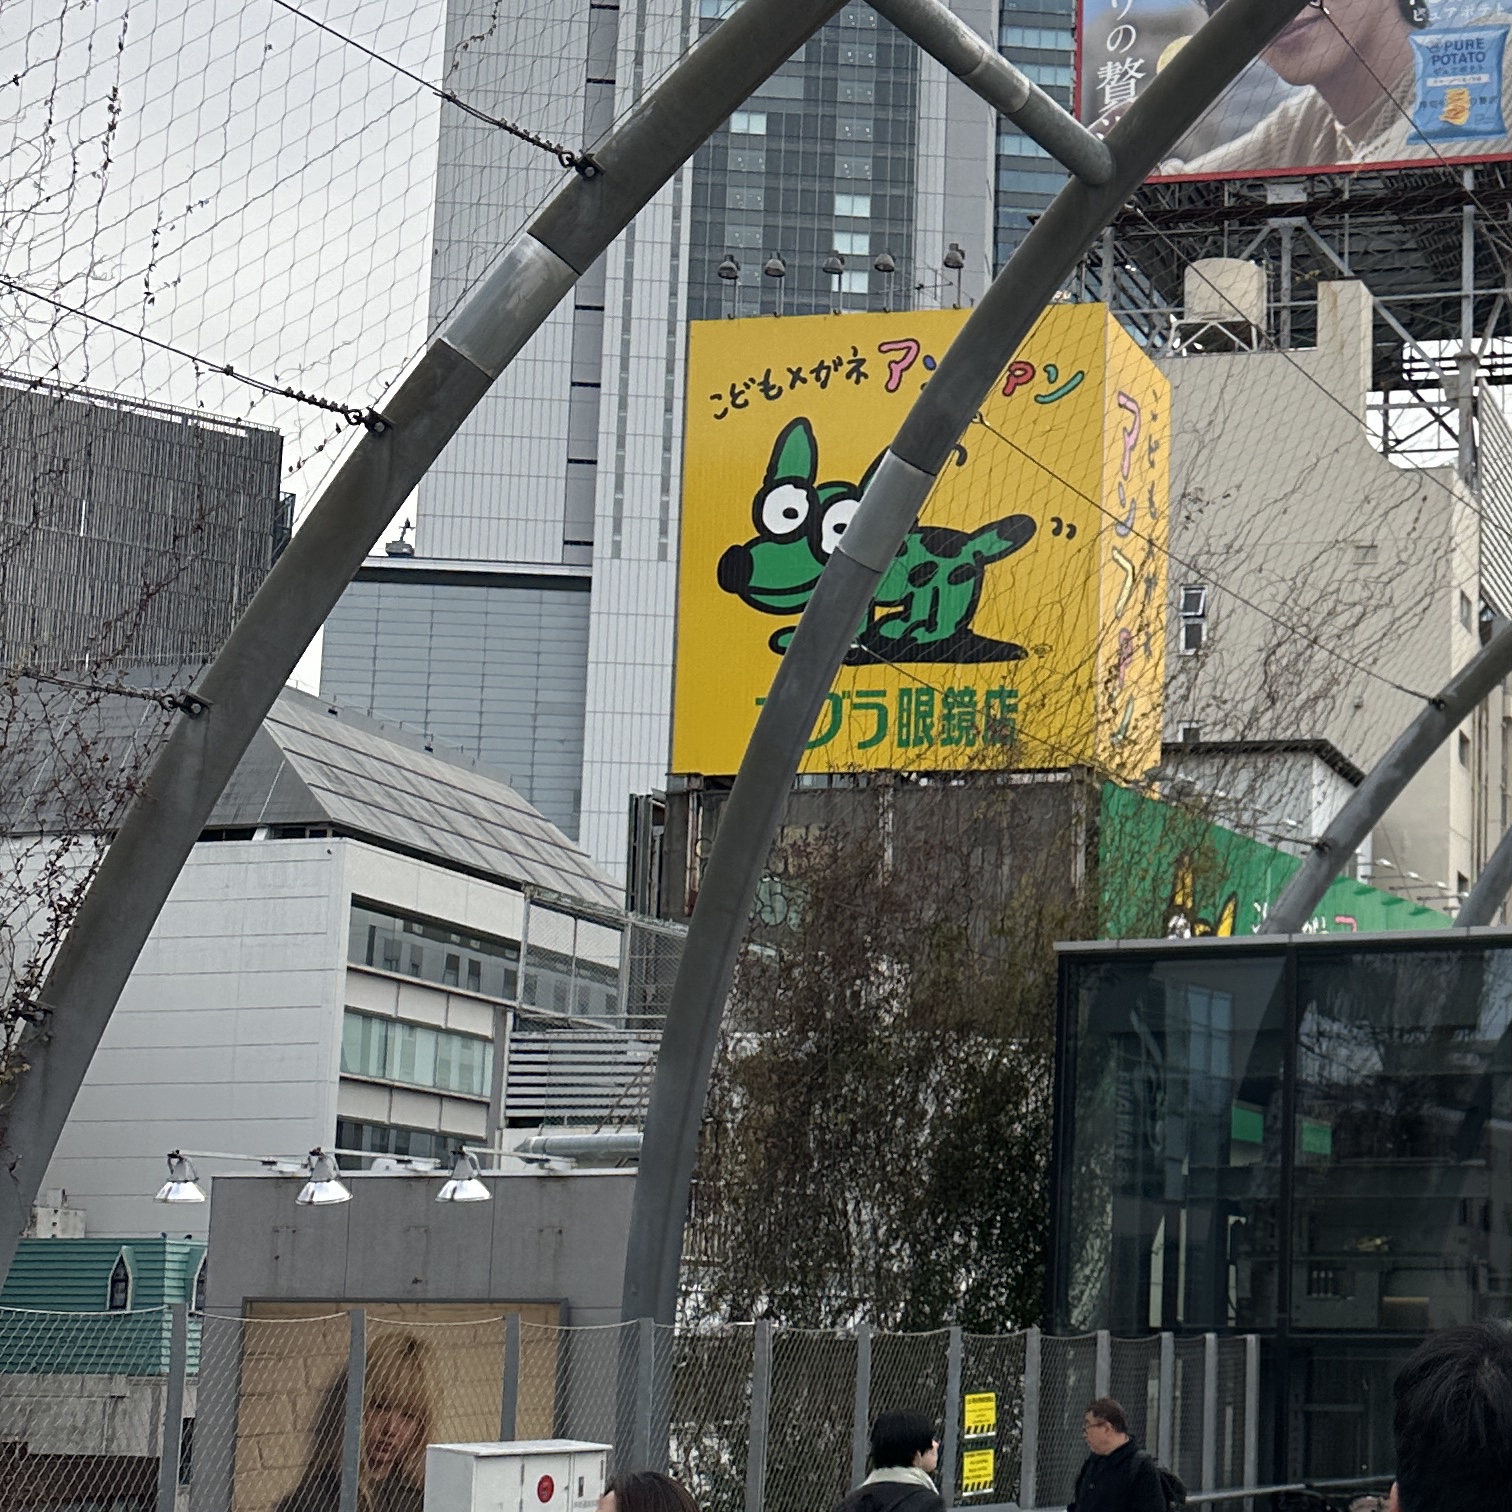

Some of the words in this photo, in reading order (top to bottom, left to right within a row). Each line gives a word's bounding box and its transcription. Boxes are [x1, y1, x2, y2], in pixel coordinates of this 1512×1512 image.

[1431, 51, 1487, 67] POTATO
[1444, 37, 1486, 53] PURE
[709, 344, 869, 419] こどもメガネ
[755, 684, 1019, 751] グラ眼鏡店
